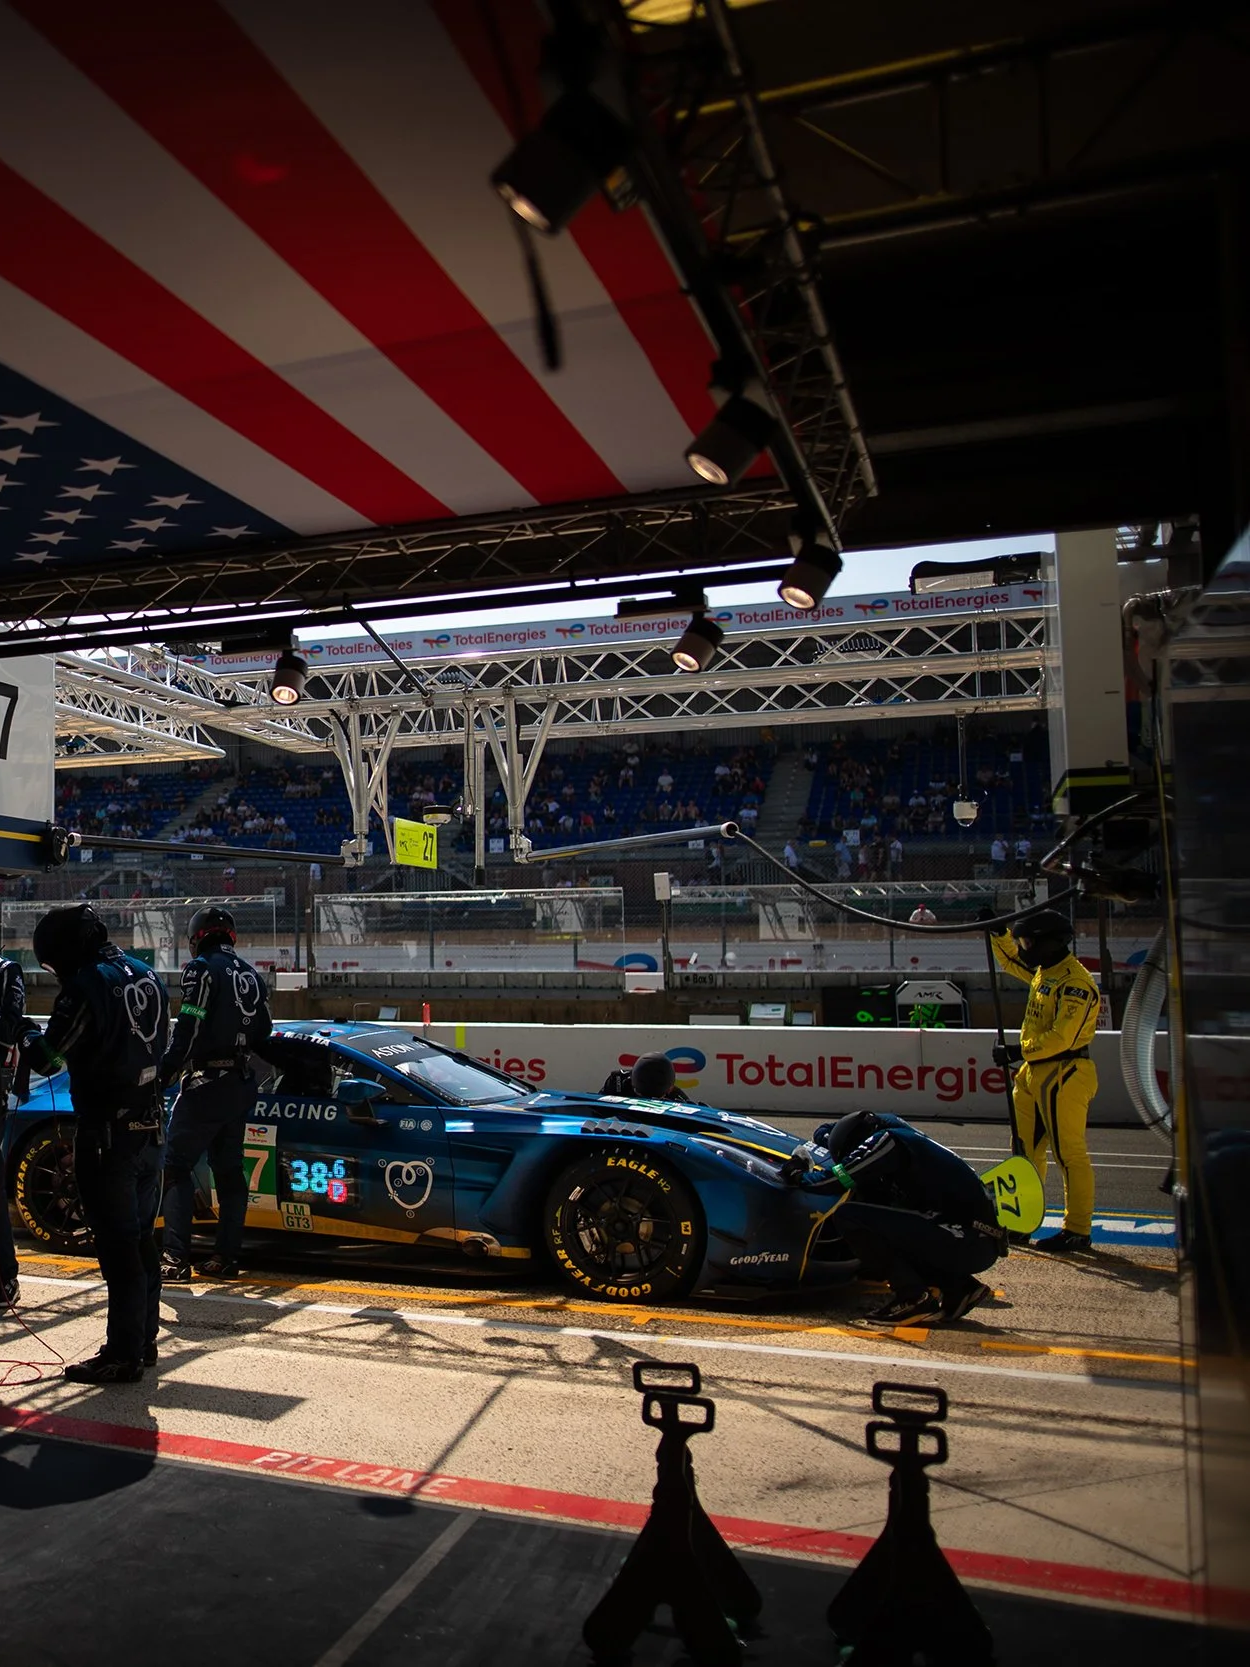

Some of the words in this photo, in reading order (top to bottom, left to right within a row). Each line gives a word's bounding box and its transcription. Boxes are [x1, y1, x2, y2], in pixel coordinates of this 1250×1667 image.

[891, 590, 1010, 613] TotalEnergies
[735, 604, 844, 626] TotalEnergies
[586, 617, 688, 637] TotalEnergies
[452, 628, 547, 648] TotalEnergies
[422, 830, 434, 862] 27
[283, 1031, 331, 1047] MATTIA
[716, 1053, 1012, 1102] TotalEnergie
[253, 1100, 339, 1121] RACING
[243, 1148, 270, 1191] 7
[605, 1155, 660, 1180] EAGLE
[657, 1176, 672, 1195] H2
[996, 1172, 1021, 1218] 27
[286, 1204, 305, 1216] LM
[286, 1216, 310, 1230] GT3
[551, 1229, 564, 1245] RF
[729, 1251, 790, 1267] GOODYEAR
[556, 1248, 652, 1298] GOODYEAR
[253, 1451, 335, 1472] PIT
[333, 1464, 458, 1494] LANE
